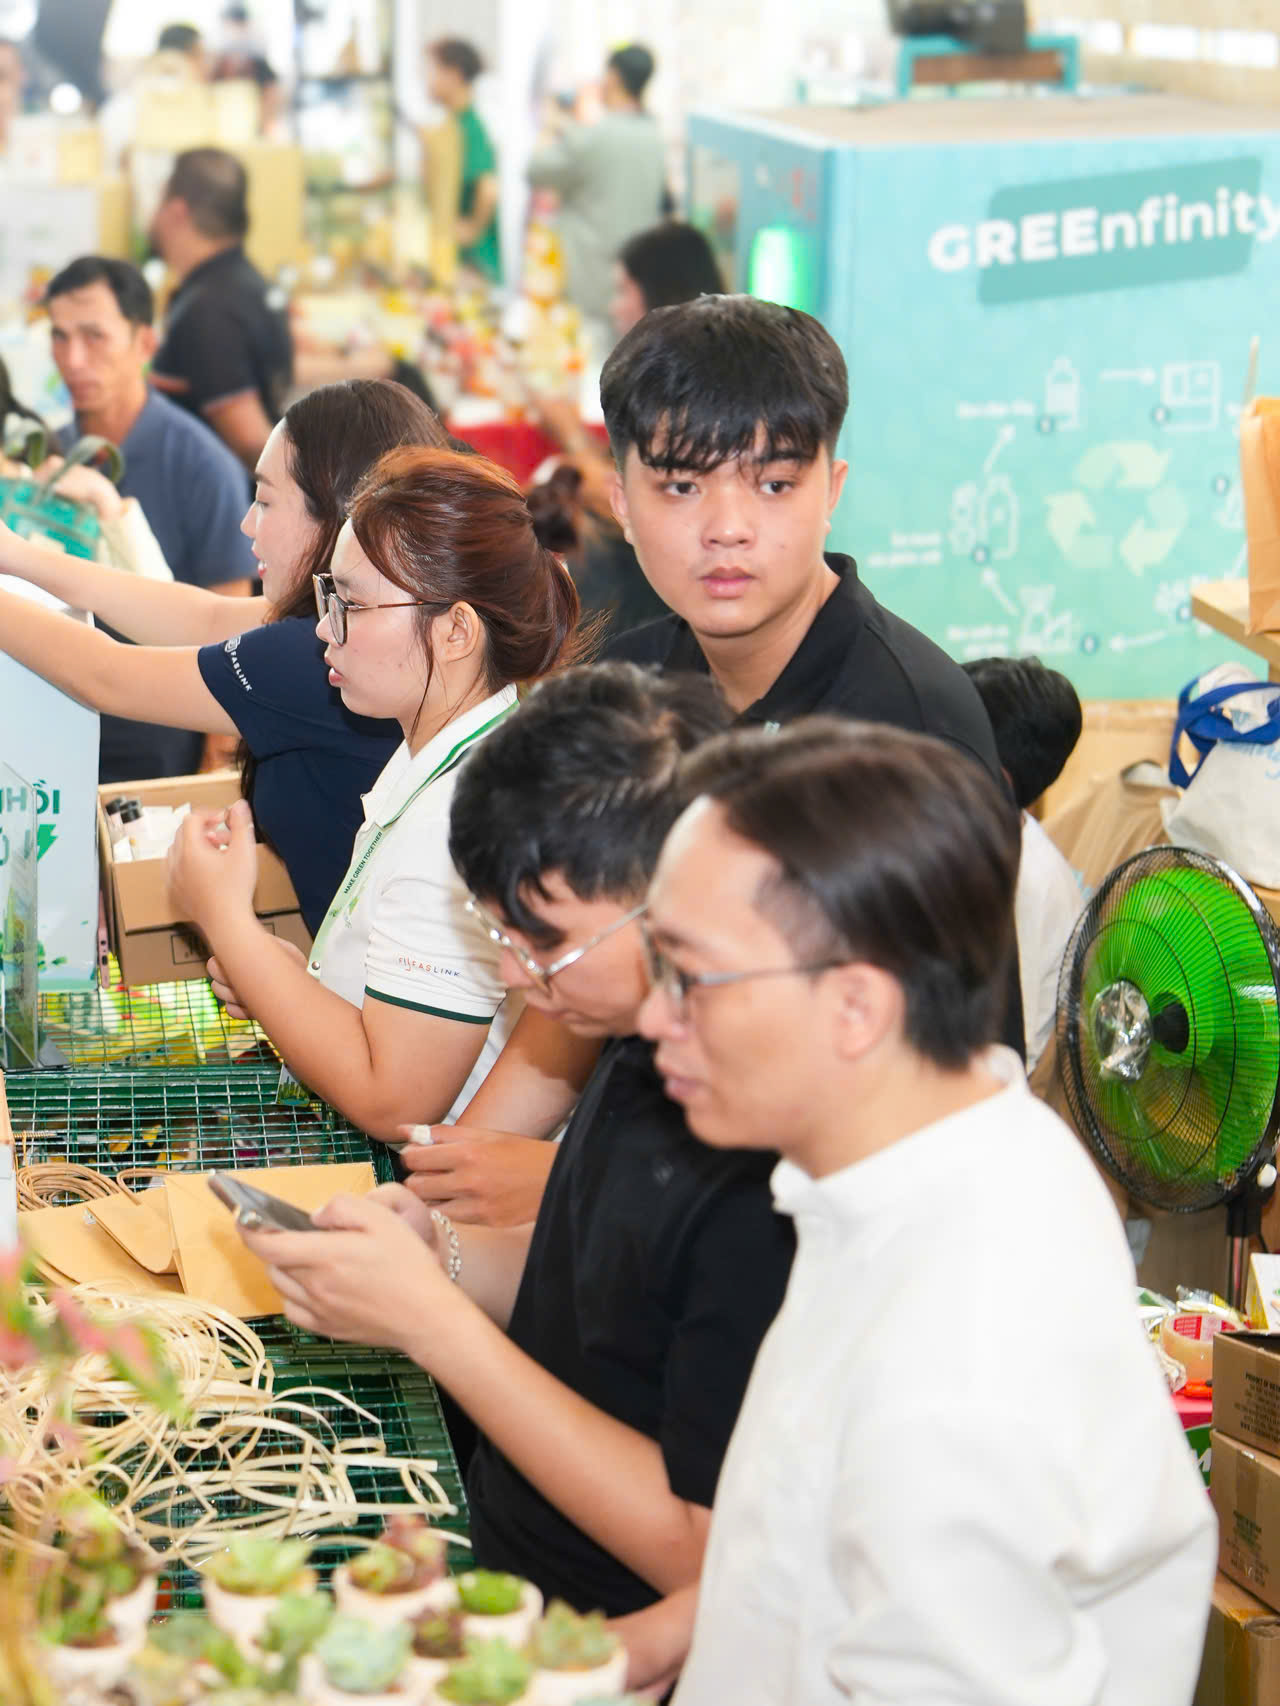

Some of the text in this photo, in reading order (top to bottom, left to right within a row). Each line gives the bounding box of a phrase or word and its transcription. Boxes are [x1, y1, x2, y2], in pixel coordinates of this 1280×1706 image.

[928, 186, 1280, 272] GREEnfinity
[231, 650, 253, 692] FASLINK
[344, 831, 383, 894] MAKE GREEN TOGETHER
